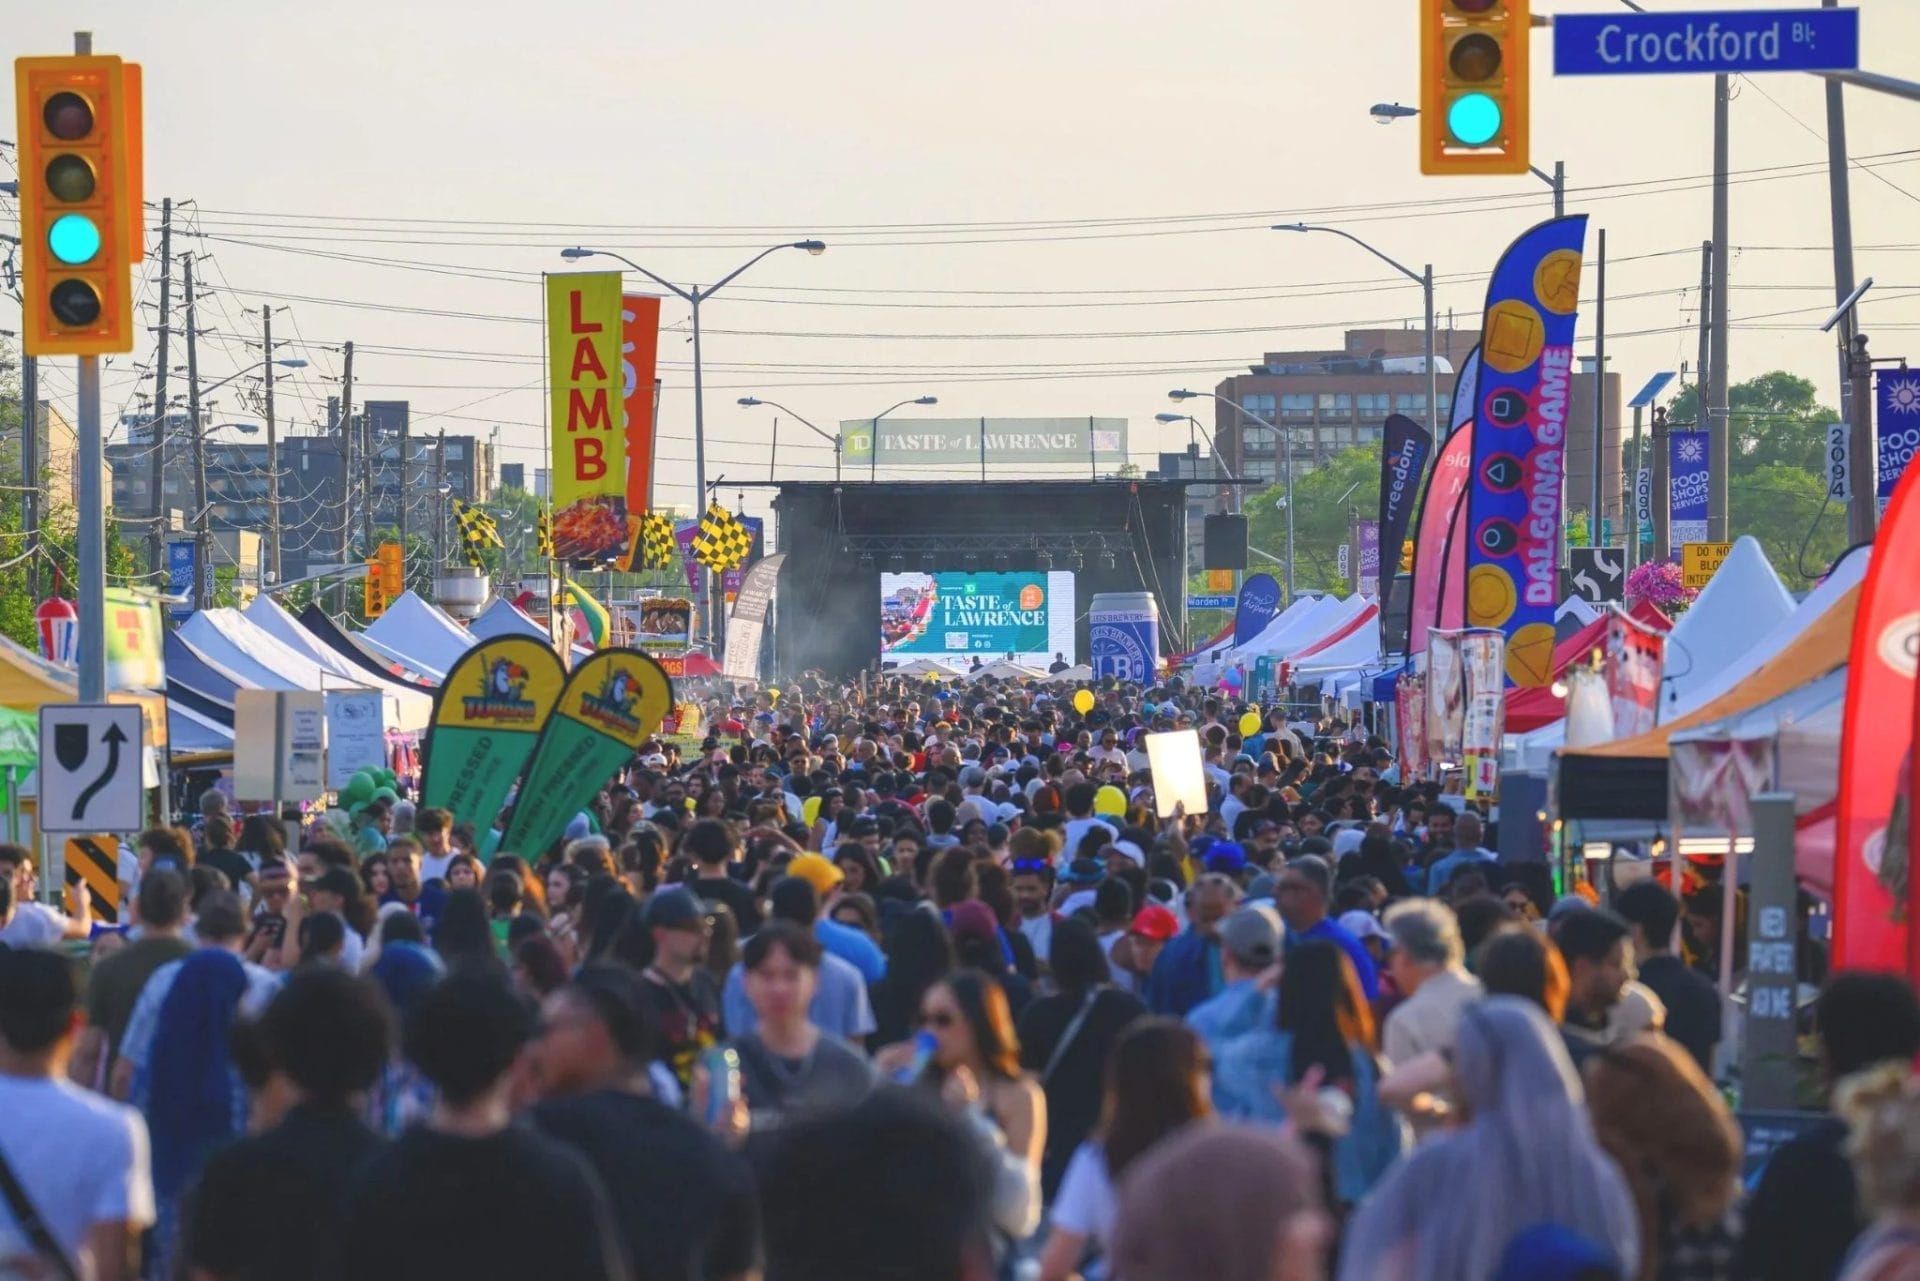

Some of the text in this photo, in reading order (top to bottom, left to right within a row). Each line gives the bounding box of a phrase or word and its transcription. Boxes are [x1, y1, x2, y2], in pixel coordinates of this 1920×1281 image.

[1597, 22, 1779, 63] Crockford
[567, 290, 612, 481] LAMB
[881, 433, 1077, 451] TASTE of LAWRENCE
[1878, 428, 1920, 453] FOO
[1831, 428, 1845, 497] 2094
[1526, 348, 1570, 604] DALGONA GAME
[1671, 470, 1709, 489] FOOD
[1639, 471, 1649, 520] 2090
[1671, 483, 1709, 501] SHOPS
[1671, 494, 1709, 511] SERVICES
[1697, 546, 1709, 557] DO
[1687, 574, 1711, 585] INTER
[941, 595, 1014, 613] TASTE of
[1188, 598, 1219, 606] Warden
[944, 611, 1045, 626] LAWRENCE
[1108, 613, 1144, 621] BREWERY
[662, 661, 682, 674] OGS
